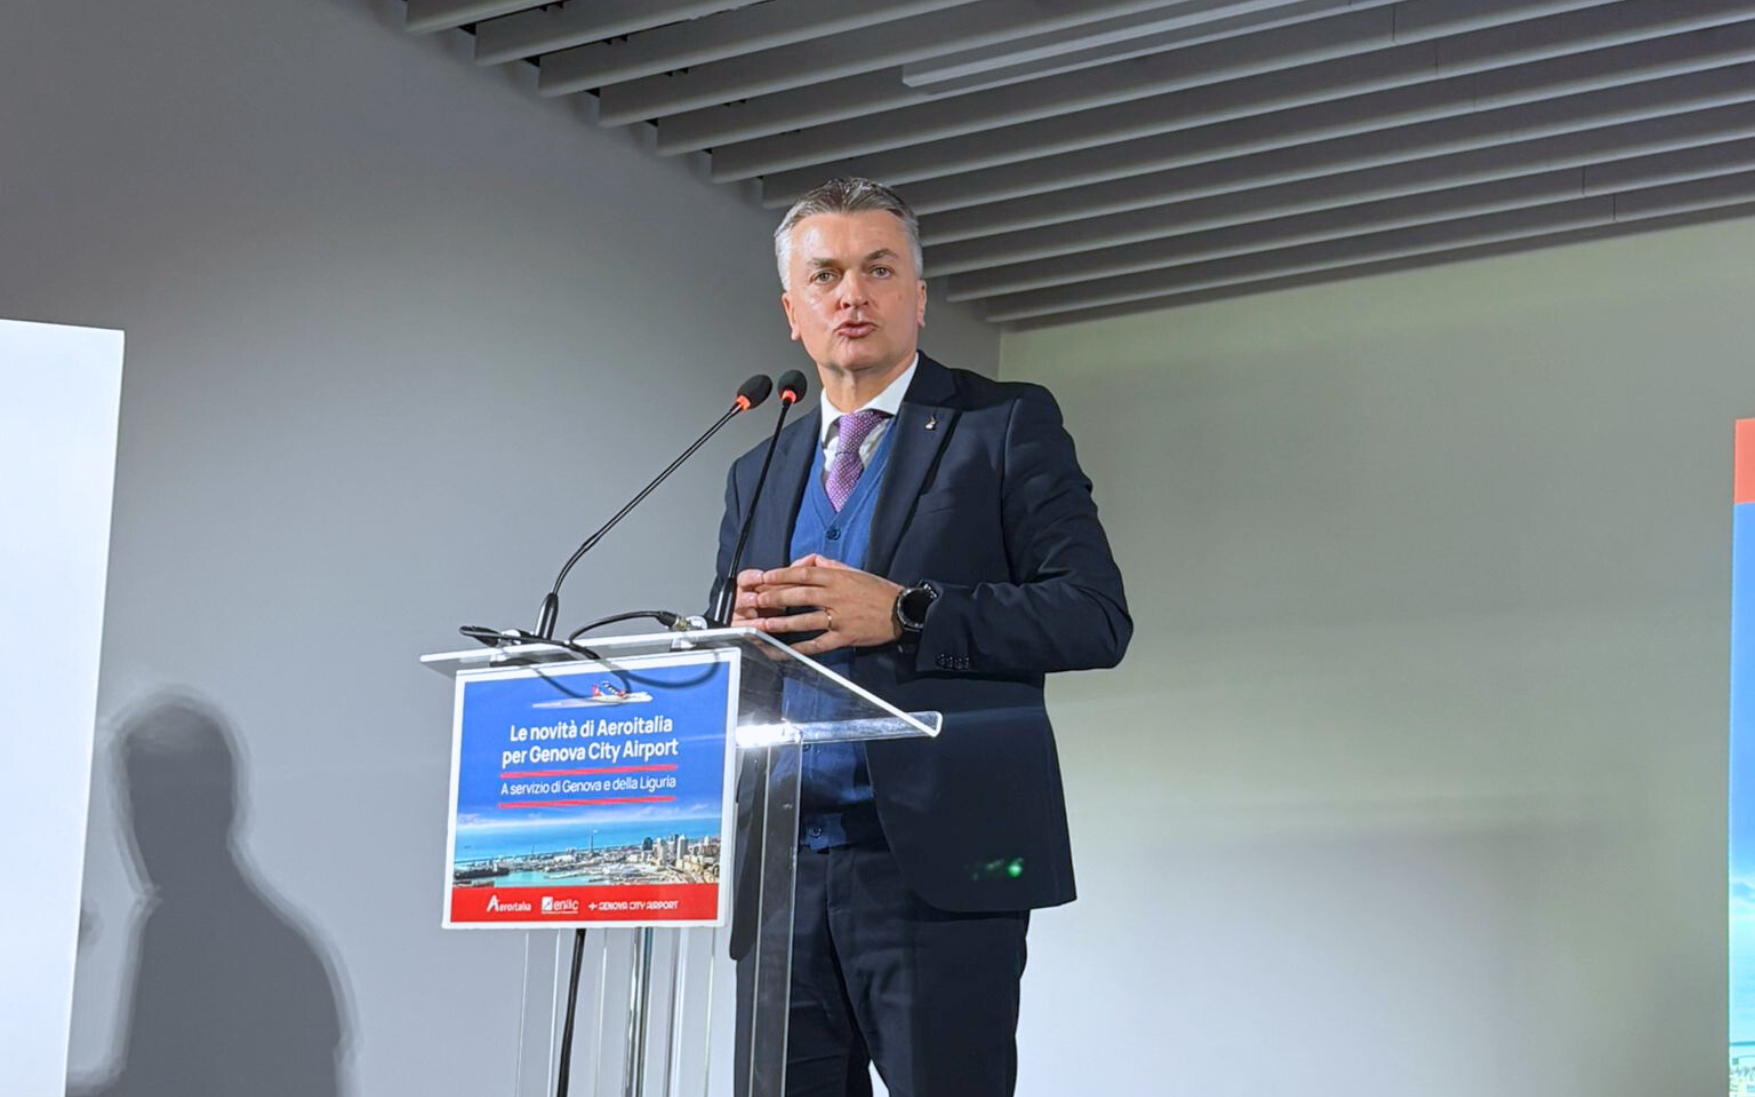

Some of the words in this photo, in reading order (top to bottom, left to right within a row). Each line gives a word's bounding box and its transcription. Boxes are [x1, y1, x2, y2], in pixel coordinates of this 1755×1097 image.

[510, 724, 527, 742] Le
[530, 719, 577, 740] novità
[580, 720, 594, 737] di
[597, 715, 673, 736] Aeroitalia
[502, 749, 527, 769] per
[529, 744, 586, 763] Genova
[588, 742, 621, 763] City
[623, 737, 678, 762] Airport
[501, 783, 509, 795] A
[510, 780, 550, 795] servizio
[551, 779, 562, 793] di
[562, 777, 602, 793] Genova
[604, 780, 610, 790] e
[612, 776, 638, 790] della
[640, 775, 676, 792] Liguria
[599, 901, 628, 911] GENOVA
[630, 901, 645, 911] CITY
[646, 900, 679, 910] AIRPORT
